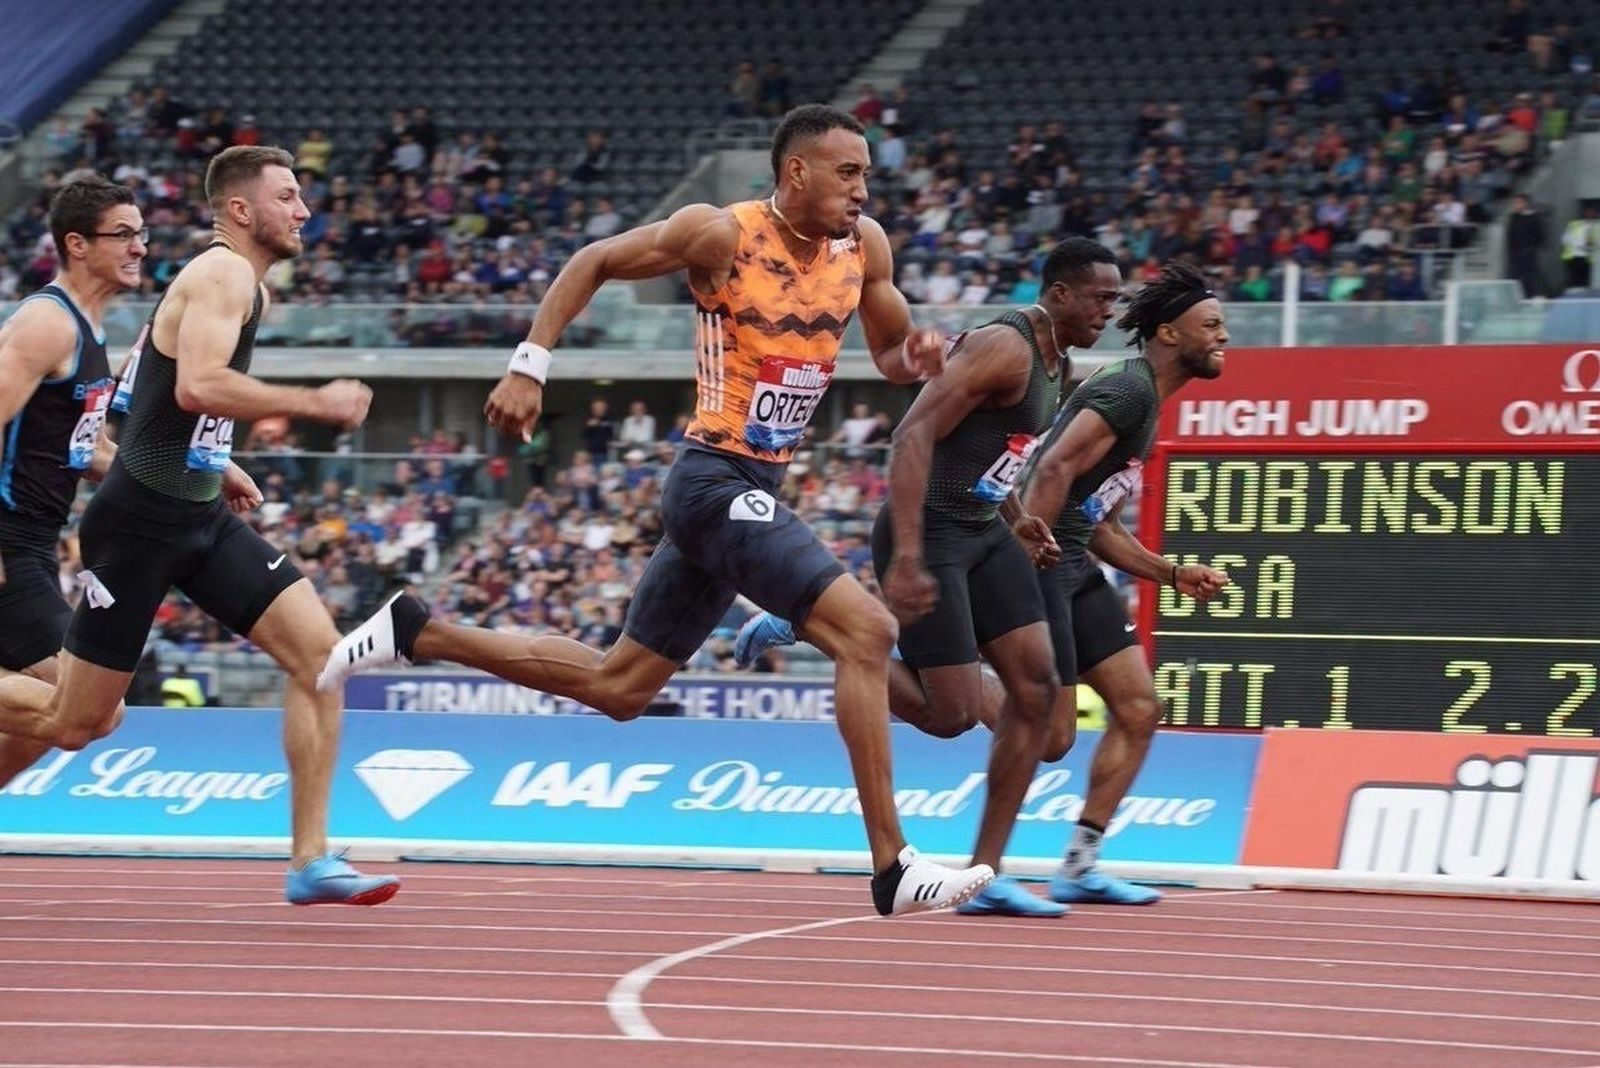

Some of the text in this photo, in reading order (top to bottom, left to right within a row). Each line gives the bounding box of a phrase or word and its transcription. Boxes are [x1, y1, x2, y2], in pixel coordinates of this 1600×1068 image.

[1178, 400, 1429, 436] HIGH JUMP
[743, 493, 769, 516] 6
[1164, 461, 1566, 534] ROBINSON
[1158, 554, 1296, 618] USA
[724, 687, 835, 720] HOME
[69, 746, 289, 815] League
[492, 761, 674, 809] IAAF
[672, 760, 988, 818] Diamnd
